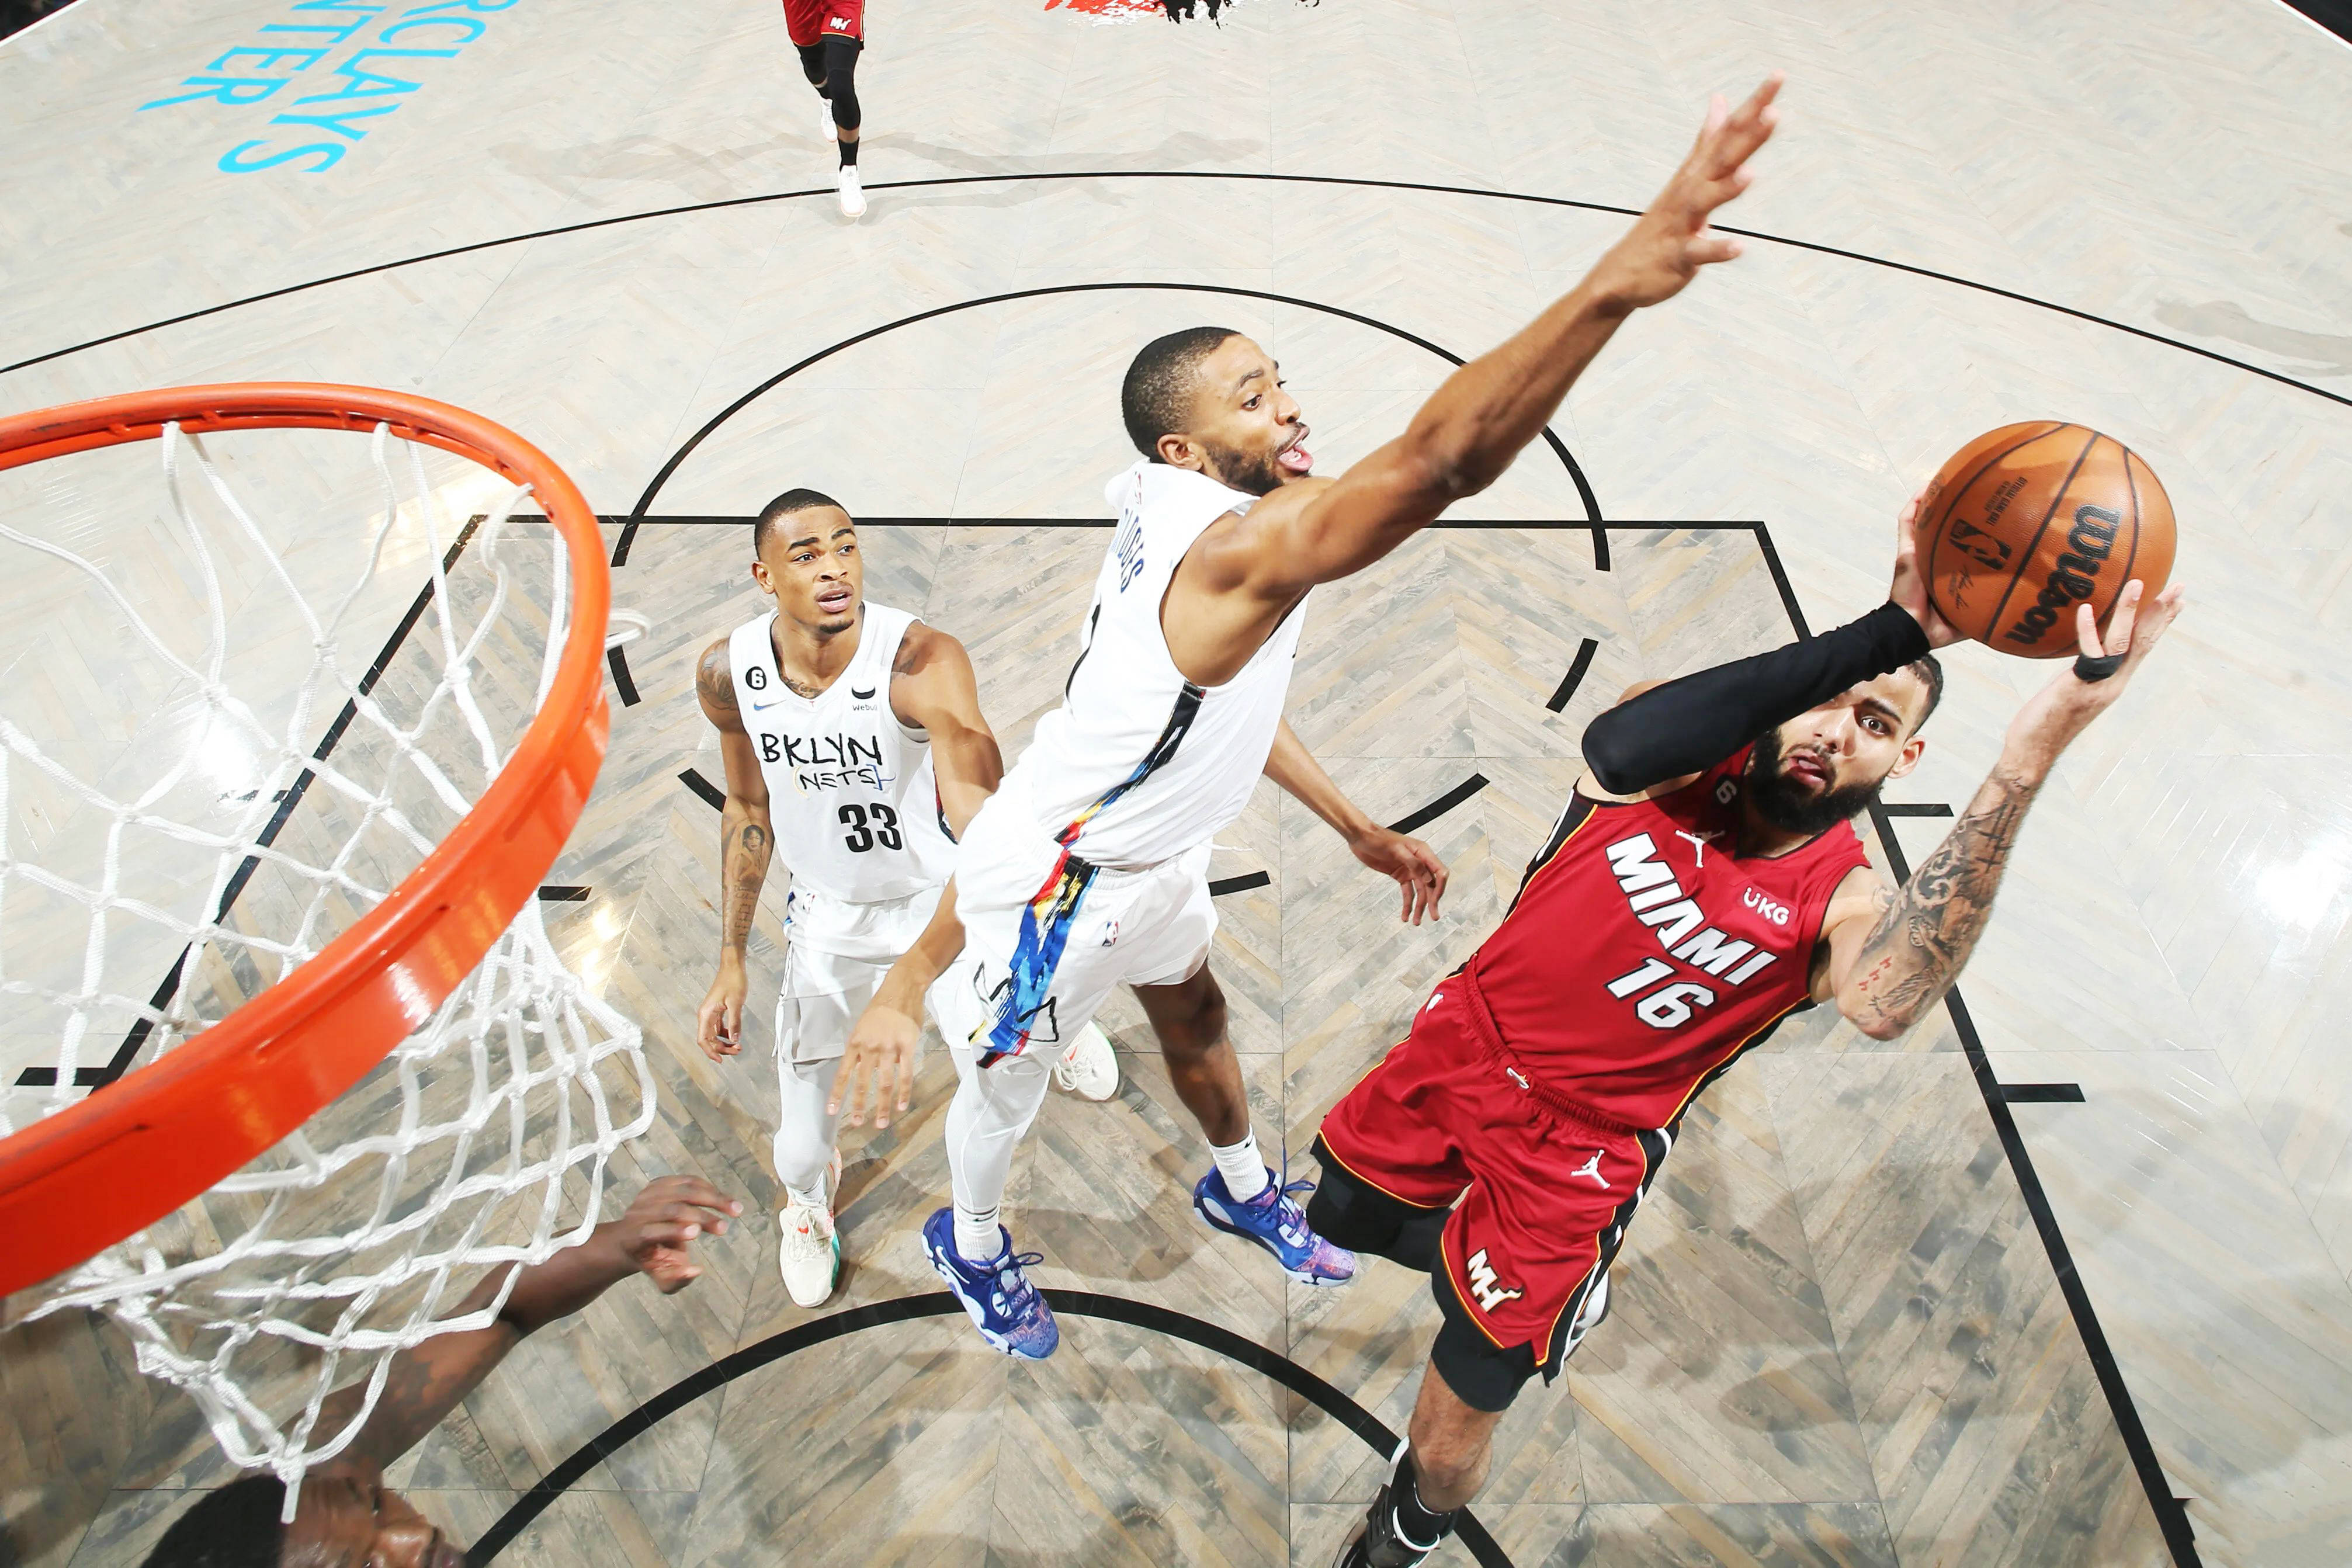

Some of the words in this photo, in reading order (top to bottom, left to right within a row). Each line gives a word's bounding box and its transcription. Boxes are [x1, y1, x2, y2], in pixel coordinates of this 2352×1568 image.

[2004, 504, 2122, 645] Wilson
[750, 669, 765, 686] 6
[761, 733, 883, 767] BKLYN
[1715, 779, 1737, 804] 6
[838, 803, 903, 853] 33
[1605, 831, 1779, 987] MIAMI
[1603, 956, 1716, 1030] 16
